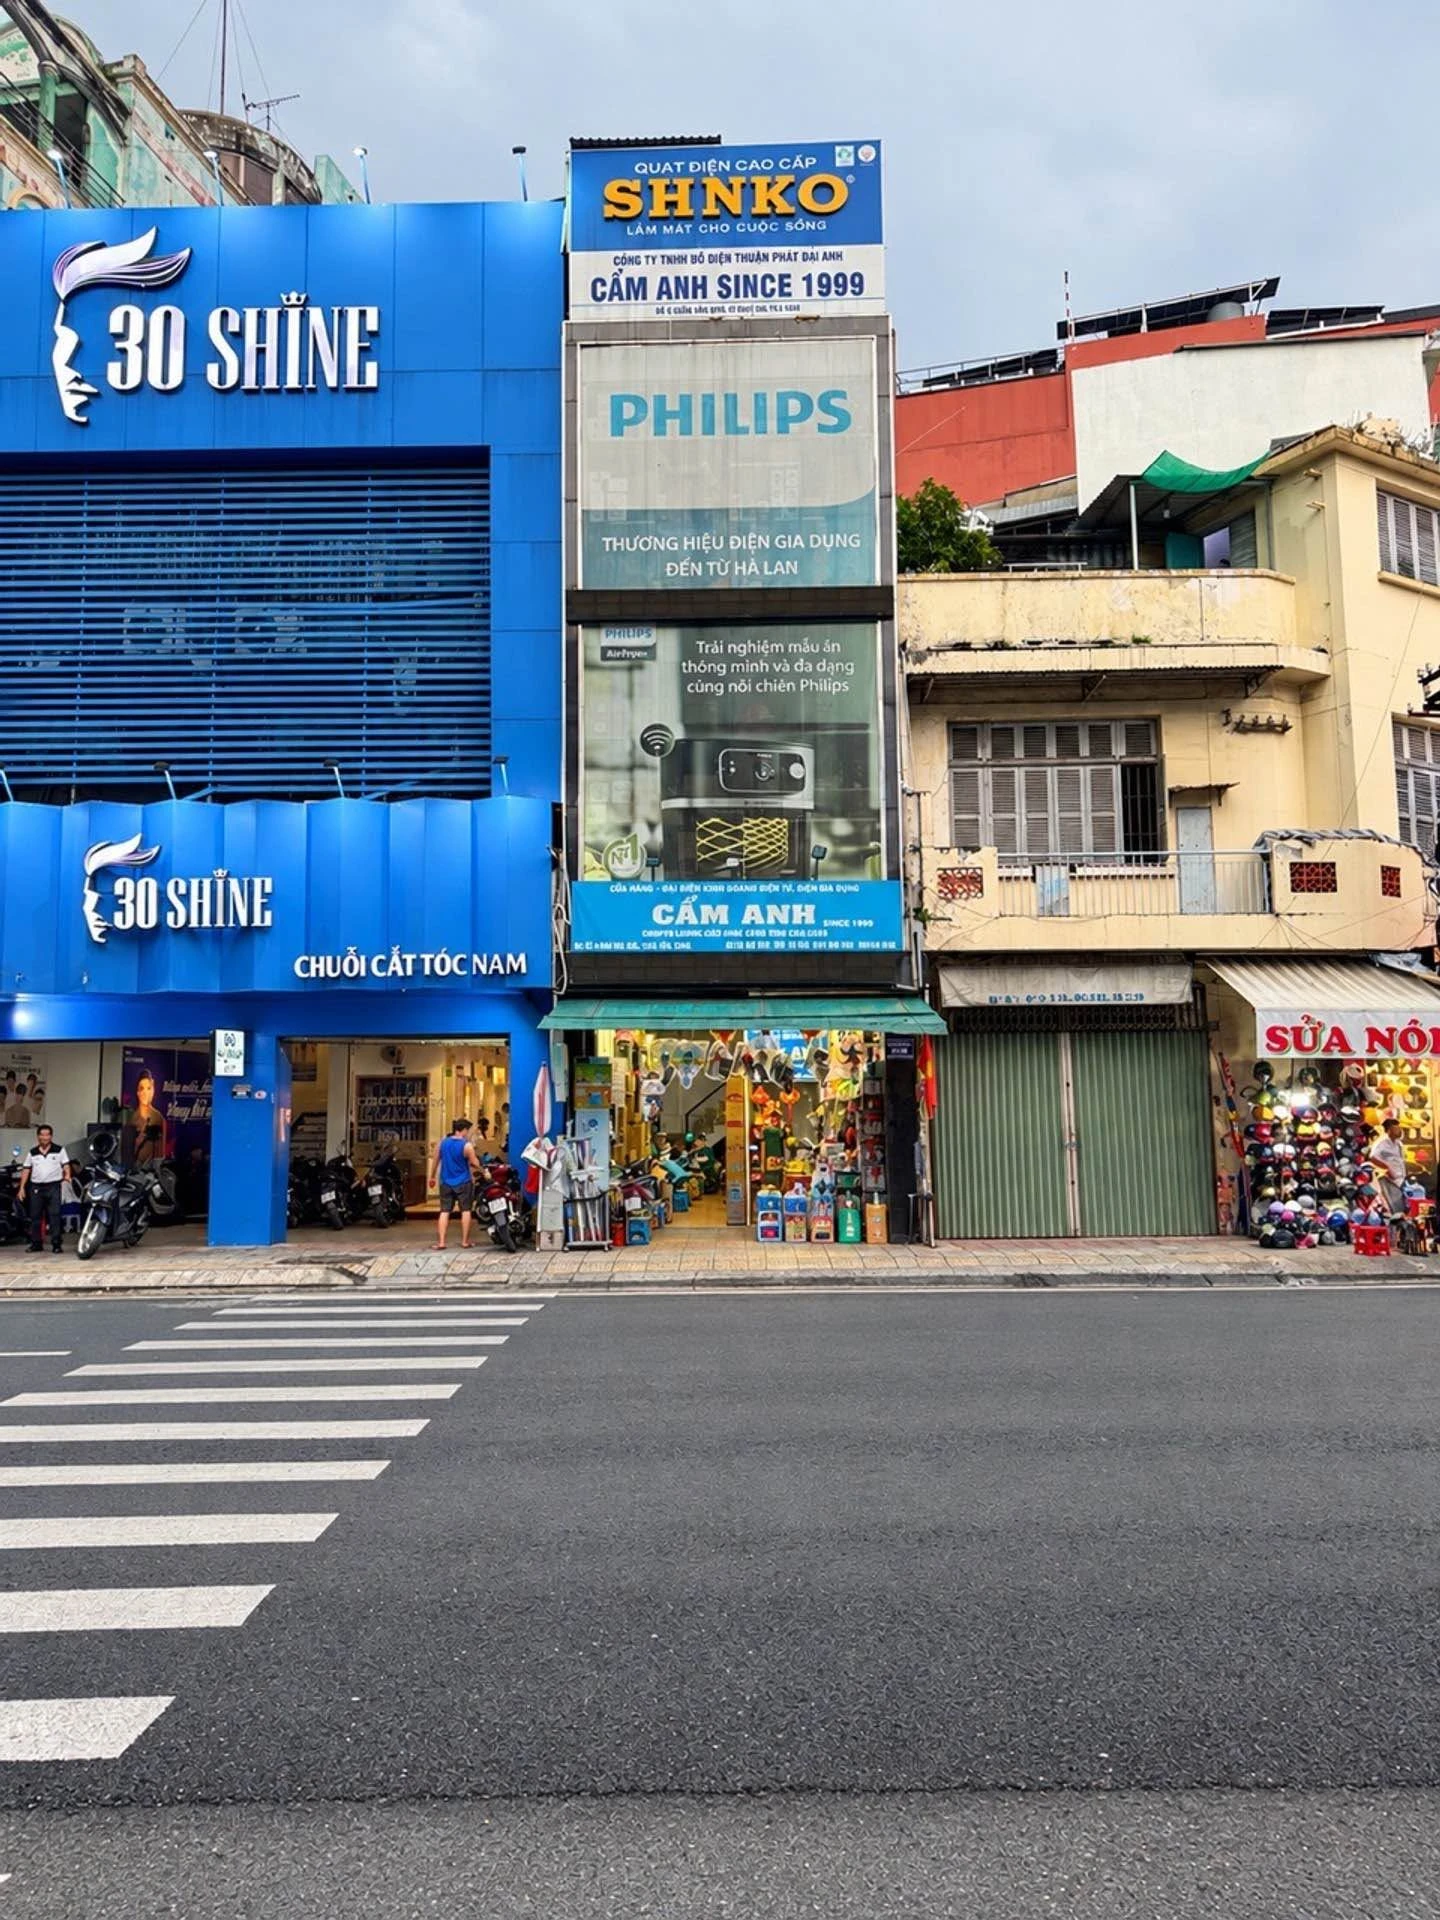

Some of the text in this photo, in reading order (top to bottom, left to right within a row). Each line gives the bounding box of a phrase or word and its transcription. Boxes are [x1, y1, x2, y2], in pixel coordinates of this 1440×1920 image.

[689, 158, 730, 176] ĐIỆN
[735, 159, 774, 171] CAO
[779, 154, 817, 169] CẤP
[603, 173, 849, 219] SHNKO
[699, 223, 730, 234] CHO
[736, 221, 779, 234] CUỘC
[785, 218, 826, 232] SỐNG
[644, 255, 657, 265] TY
[660, 254, 688, 265] TNHH
[822, 250, 843, 262] ANH
[656, 276, 708, 300] ANH
[717, 273, 792, 299] SINCE
[802, 271, 865, 297] 1999
[107, 303, 379, 391] 30 SHINE
[609, 390, 851, 437] PHILIPS
[602, 533, 861, 555] THƯƠNG HIỆU ĐIỆN GIA DỤNG
[666, 557, 702, 576] ĐẾN
[706, 559, 731, 576] TỪ
[764, 560, 798, 575] LAN
[727, 640, 784, 657] nghiệm
[730, 659, 769, 673] minh
[773, 660, 790, 673] và
[816, 659, 855, 676] dạng
[800, 678, 849, 696] Philips
[113, 876, 272, 929] 30 SHINE
[741, 903, 816, 925] ANH
[294, 945, 528, 978] CHUỖI CẮT TÓC NAM
[1265, 1014, 1354, 1054] SỬA
